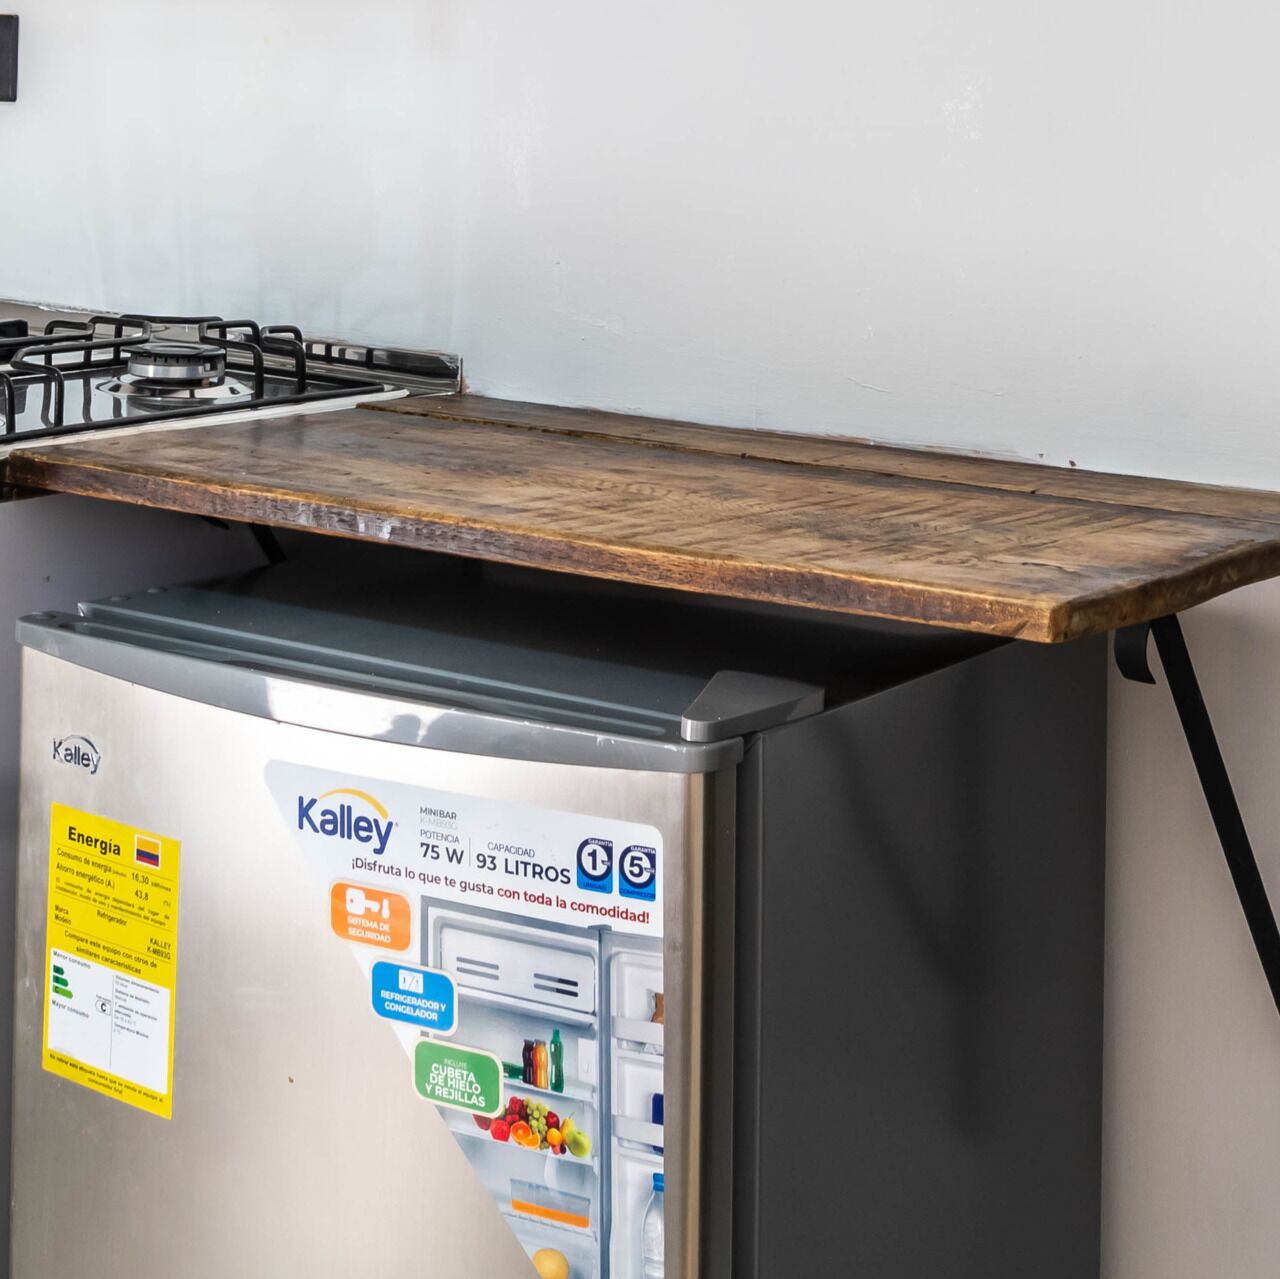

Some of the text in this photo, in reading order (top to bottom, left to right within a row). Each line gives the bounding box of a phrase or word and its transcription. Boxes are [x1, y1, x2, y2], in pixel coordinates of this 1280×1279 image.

[53, 738, 101, 774] Kalley
[420, 806, 457, 820] MINIBAR
[298, 795, 394, 855] Kalley
[68, 826, 121, 856] Energía
[420, 829, 460, 844] POTENCIA
[57, 848, 82, 863] Consumo
[84, 856, 90, 865] de
[420, 842, 464, 865] 75 W
[487, 841, 535, 858] CAPACIDAD
[587, 848, 597, 871] 1
[476, 853, 571, 885] 93 LITROS
[629, 855, 644, 878] 5
[56, 863, 75, 875] Ahorro
[76, 869, 104, 885] energético
[134, 890, 149, 901] 43,8
[352, 857, 650, 924] ¡Disfruta lo que te gusta con toda la comodidad!
[54, 904, 69, 915] Marca
[54, 914, 72, 925] Modelo
[97, 909, 127, 926] Refrigerador
[347, 916, 390, 932] SISTEMA DE
[150, 938, 171, 950] KALLEY
[348, 927, 391, 943] SEGURIDAD
[76, 946, 100, 959] similares
[102, 944, 121, 956] equipo
[122, 951, 132, 959] con
[134, 955, 148, 965] otros
[150, 960, 157, 968] de
[100, 1002, 106, 1013] C
[381, 989, 446, 1013] REFRIGERADOR Y
[384, 1001, 438, 1021] CONGELADOR
[431, 1063, 476, 1083] CUBETA
[444, 1058, 468, 1069] INCLUYE
[429, 1073, 481, 1095] DE HIELO
[425, 1083, 486, 1107] Y REJILLAS
